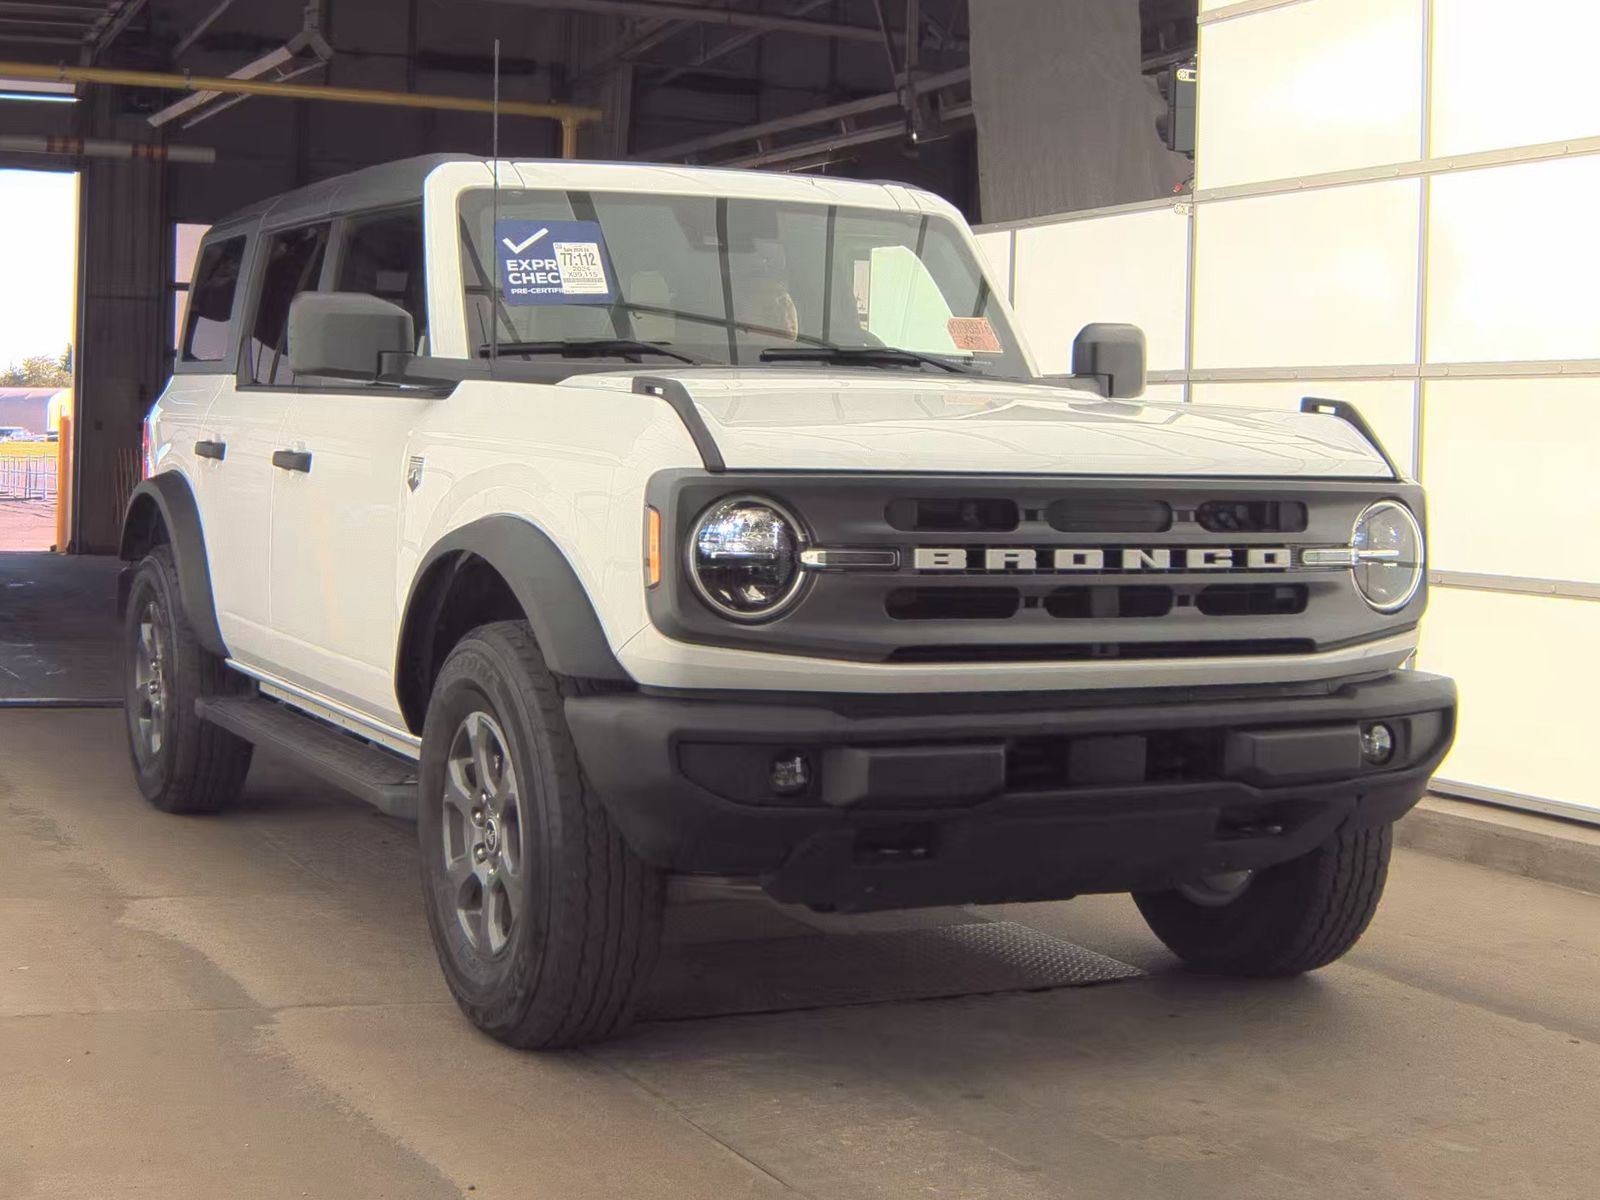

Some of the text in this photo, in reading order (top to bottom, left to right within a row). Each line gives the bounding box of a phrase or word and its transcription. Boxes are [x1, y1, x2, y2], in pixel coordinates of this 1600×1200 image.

[506, 259, 558, 271] EXPR
[560, 252, 597, 266] 77:112
[508, 272, 561, 284] CHEC
[511, 287, 565, 295] PRE-CERTIFI
[914, 548, 1291, 569] BRONCO
